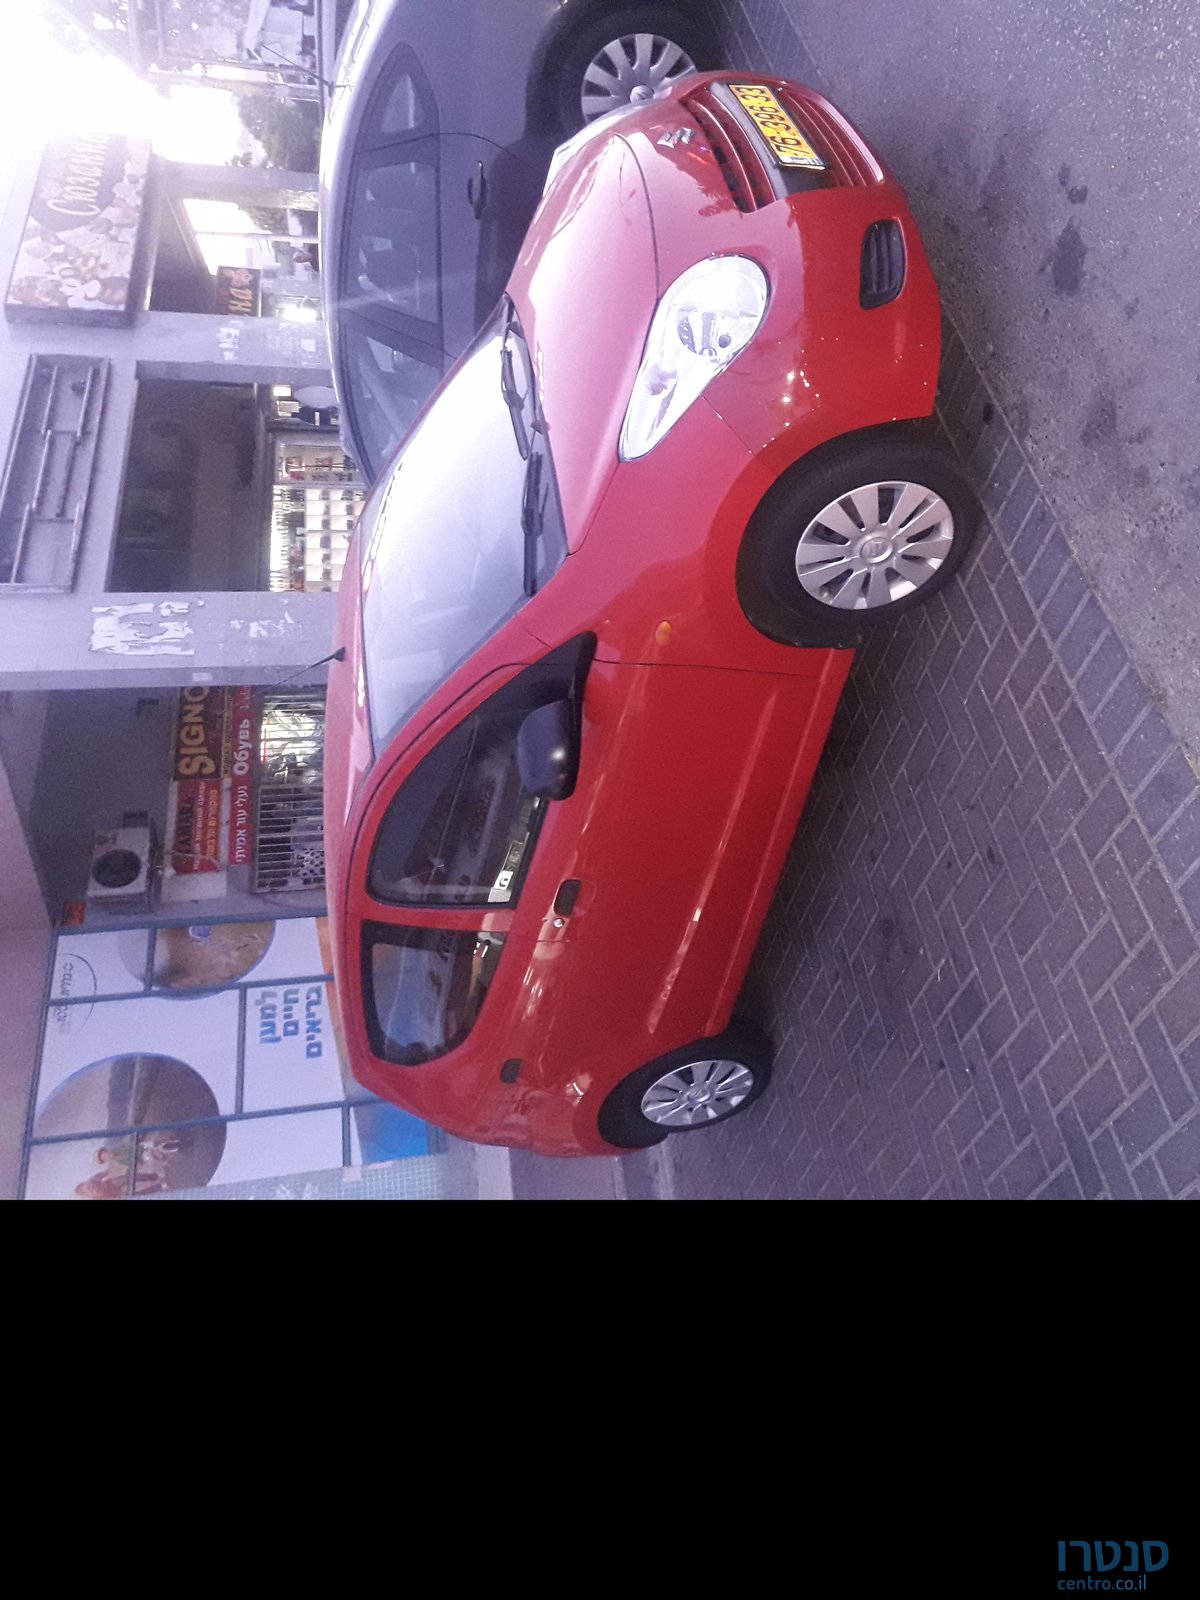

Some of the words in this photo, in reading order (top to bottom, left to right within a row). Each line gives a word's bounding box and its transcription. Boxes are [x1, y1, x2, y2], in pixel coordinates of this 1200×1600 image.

[46, 130, 109, 216] Сюзанна
[233, 718, 252, 776] Обувь
[234, 785, 248, 806] נעלי
[236, 810, 247, 826] עור
[235, 829, 247, 862] אמיתי
[254, 991, 282, 1044] למען
[283, 988, 299, 1037] חיים
[306, 985, 322, 1059] בריאים
